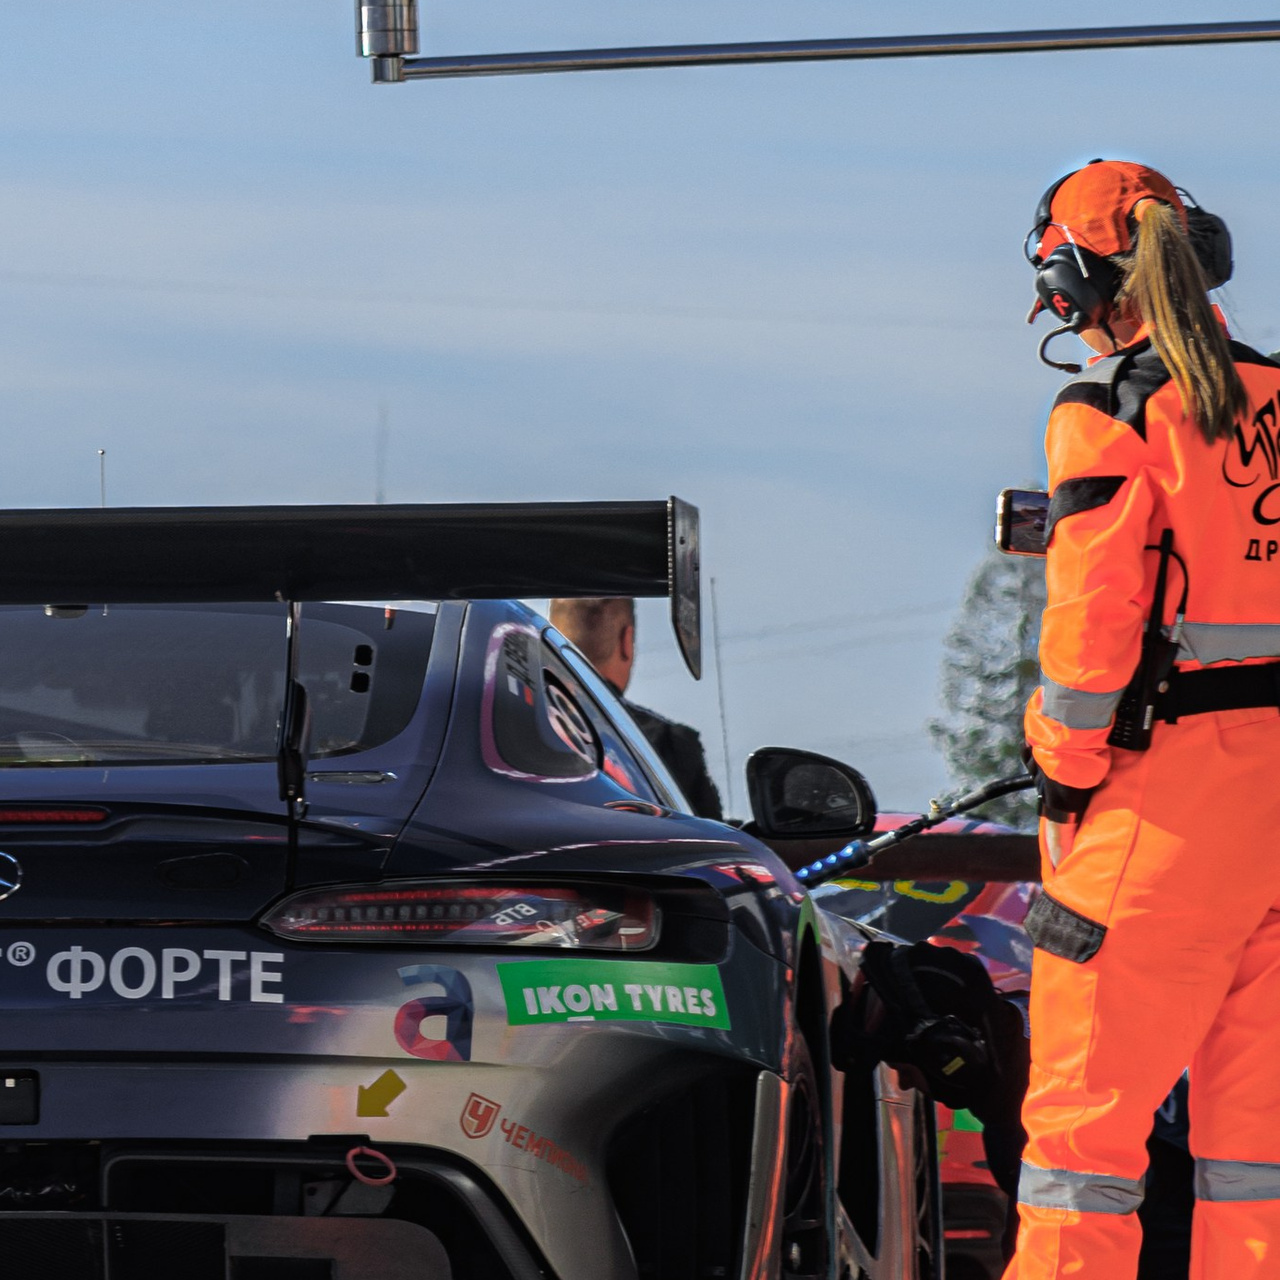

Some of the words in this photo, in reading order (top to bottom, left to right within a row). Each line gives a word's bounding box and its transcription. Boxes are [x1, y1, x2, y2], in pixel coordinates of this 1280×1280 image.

[46, 946, 285, 1004] ФОРТЕ
[522, 983, 618, 1016] IKON
[624, 984, 716, 1017] TYRES
